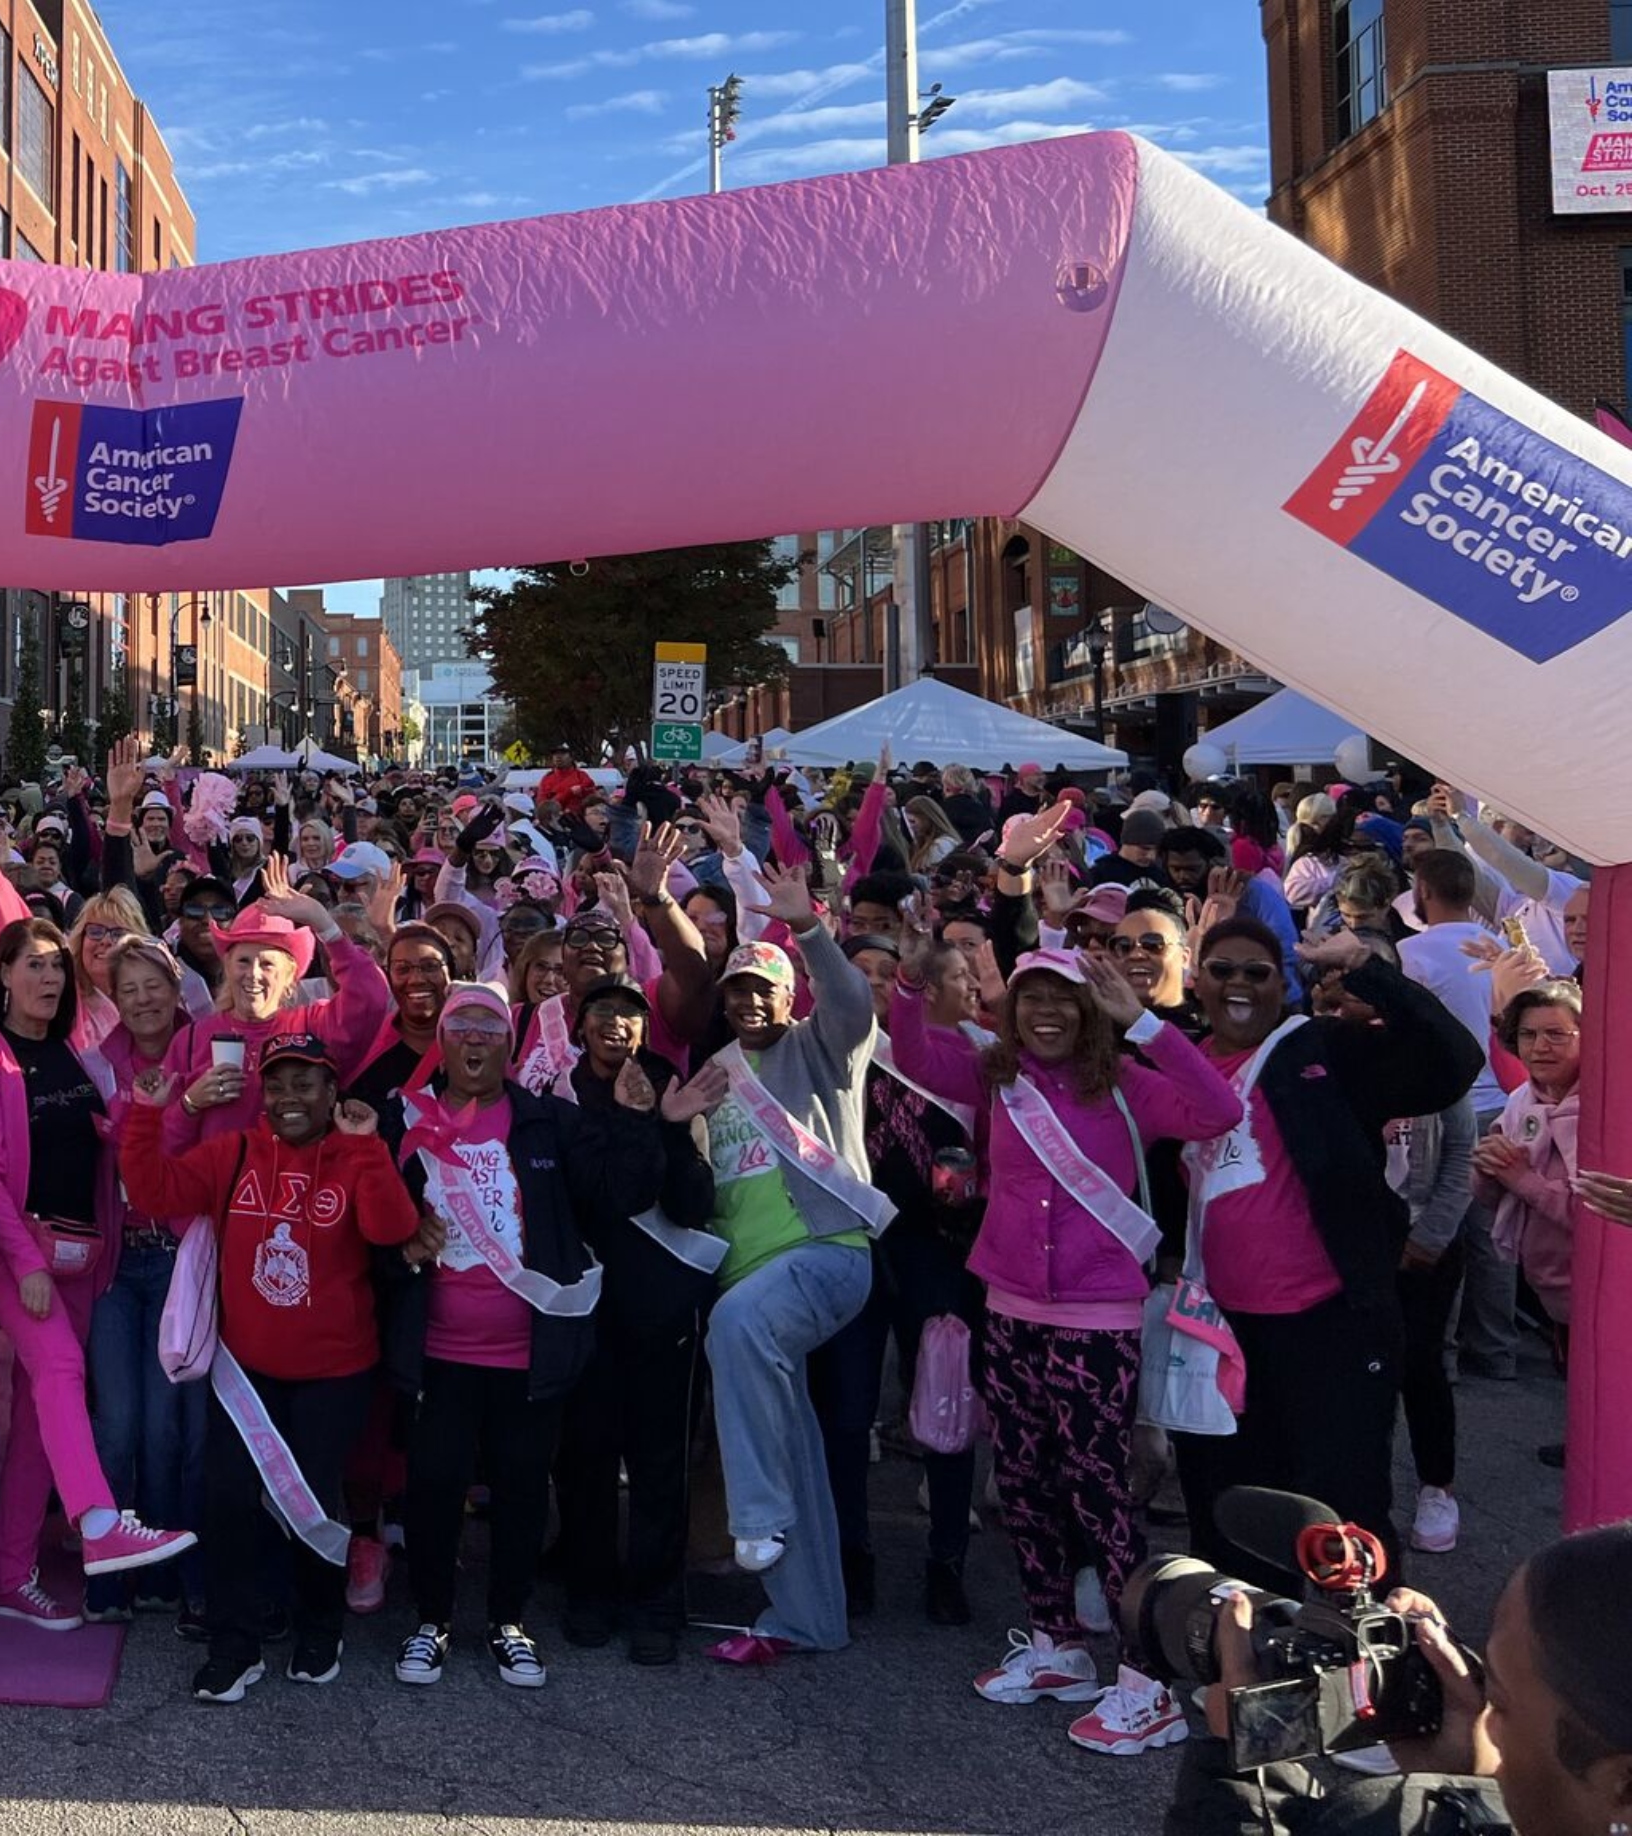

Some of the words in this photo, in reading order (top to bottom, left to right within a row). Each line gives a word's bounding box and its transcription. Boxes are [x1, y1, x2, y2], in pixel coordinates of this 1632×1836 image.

[244, 270, 465, 329] STRIDES
[174, 334, 310, 380] Breast
[86, 467, 175, 496] Cancer
[1429, 464, 1578, 563] Cancer
[659, 668, 701, 680] SPEED
[663, 681, 695, 691] LIMIT
[659, 693, 699, 715] 20
[450, 1197, 508, 1270] Survivor
